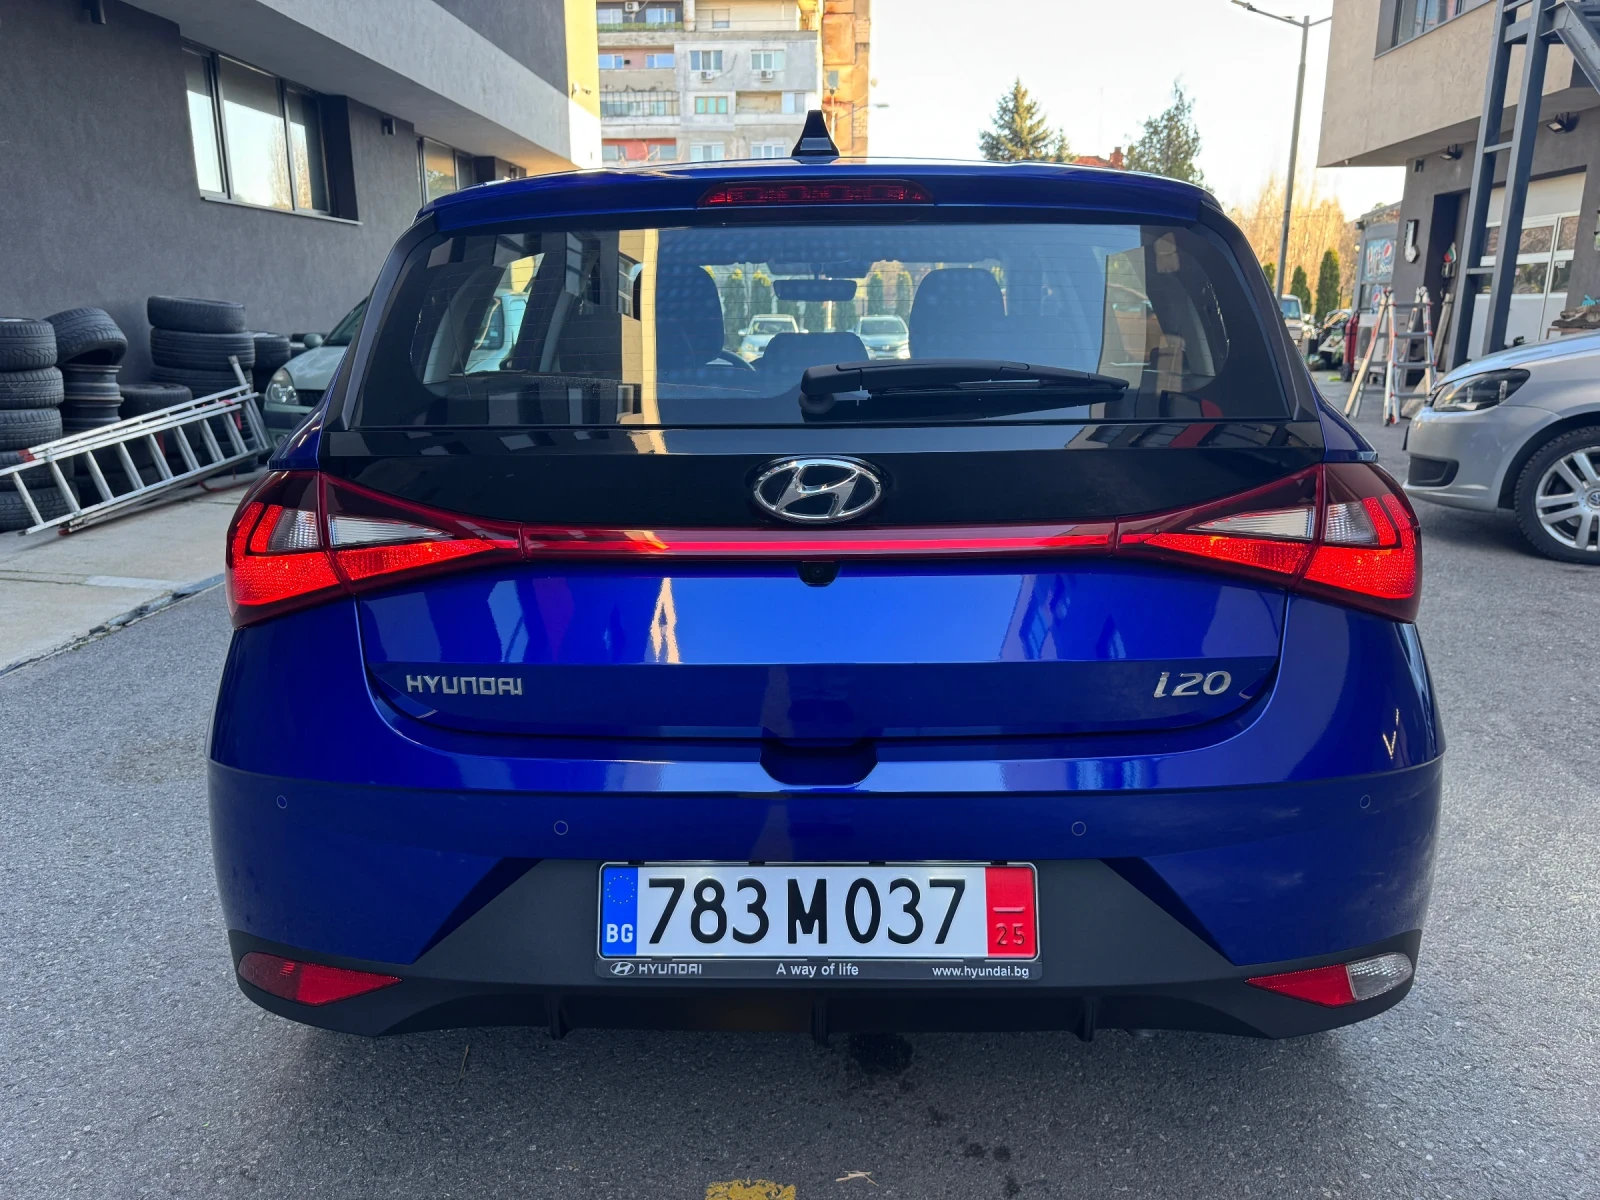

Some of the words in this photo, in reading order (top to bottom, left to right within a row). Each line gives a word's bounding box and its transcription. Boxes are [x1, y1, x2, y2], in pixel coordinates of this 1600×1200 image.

[405, 674, 523, 696] HYUNDAI
[1153, 670, 1232, 698] i20
[648, 877, 770, 945] 783
[787, 878, 828, 945] M
[844, 877, 966, 945] 037
[606, 923, 634, 943] BG
[995, 922, 1026, 946] 25
[638, 963, 702, 975] HYUNDAI
[776, 963, 787, 976] A
[790, 965, 817, 978] way
[821, 963, 835, 976] of
[838, 963, 859, 976] life
[932, 964, 1030, 979] www.hyundai.bg
